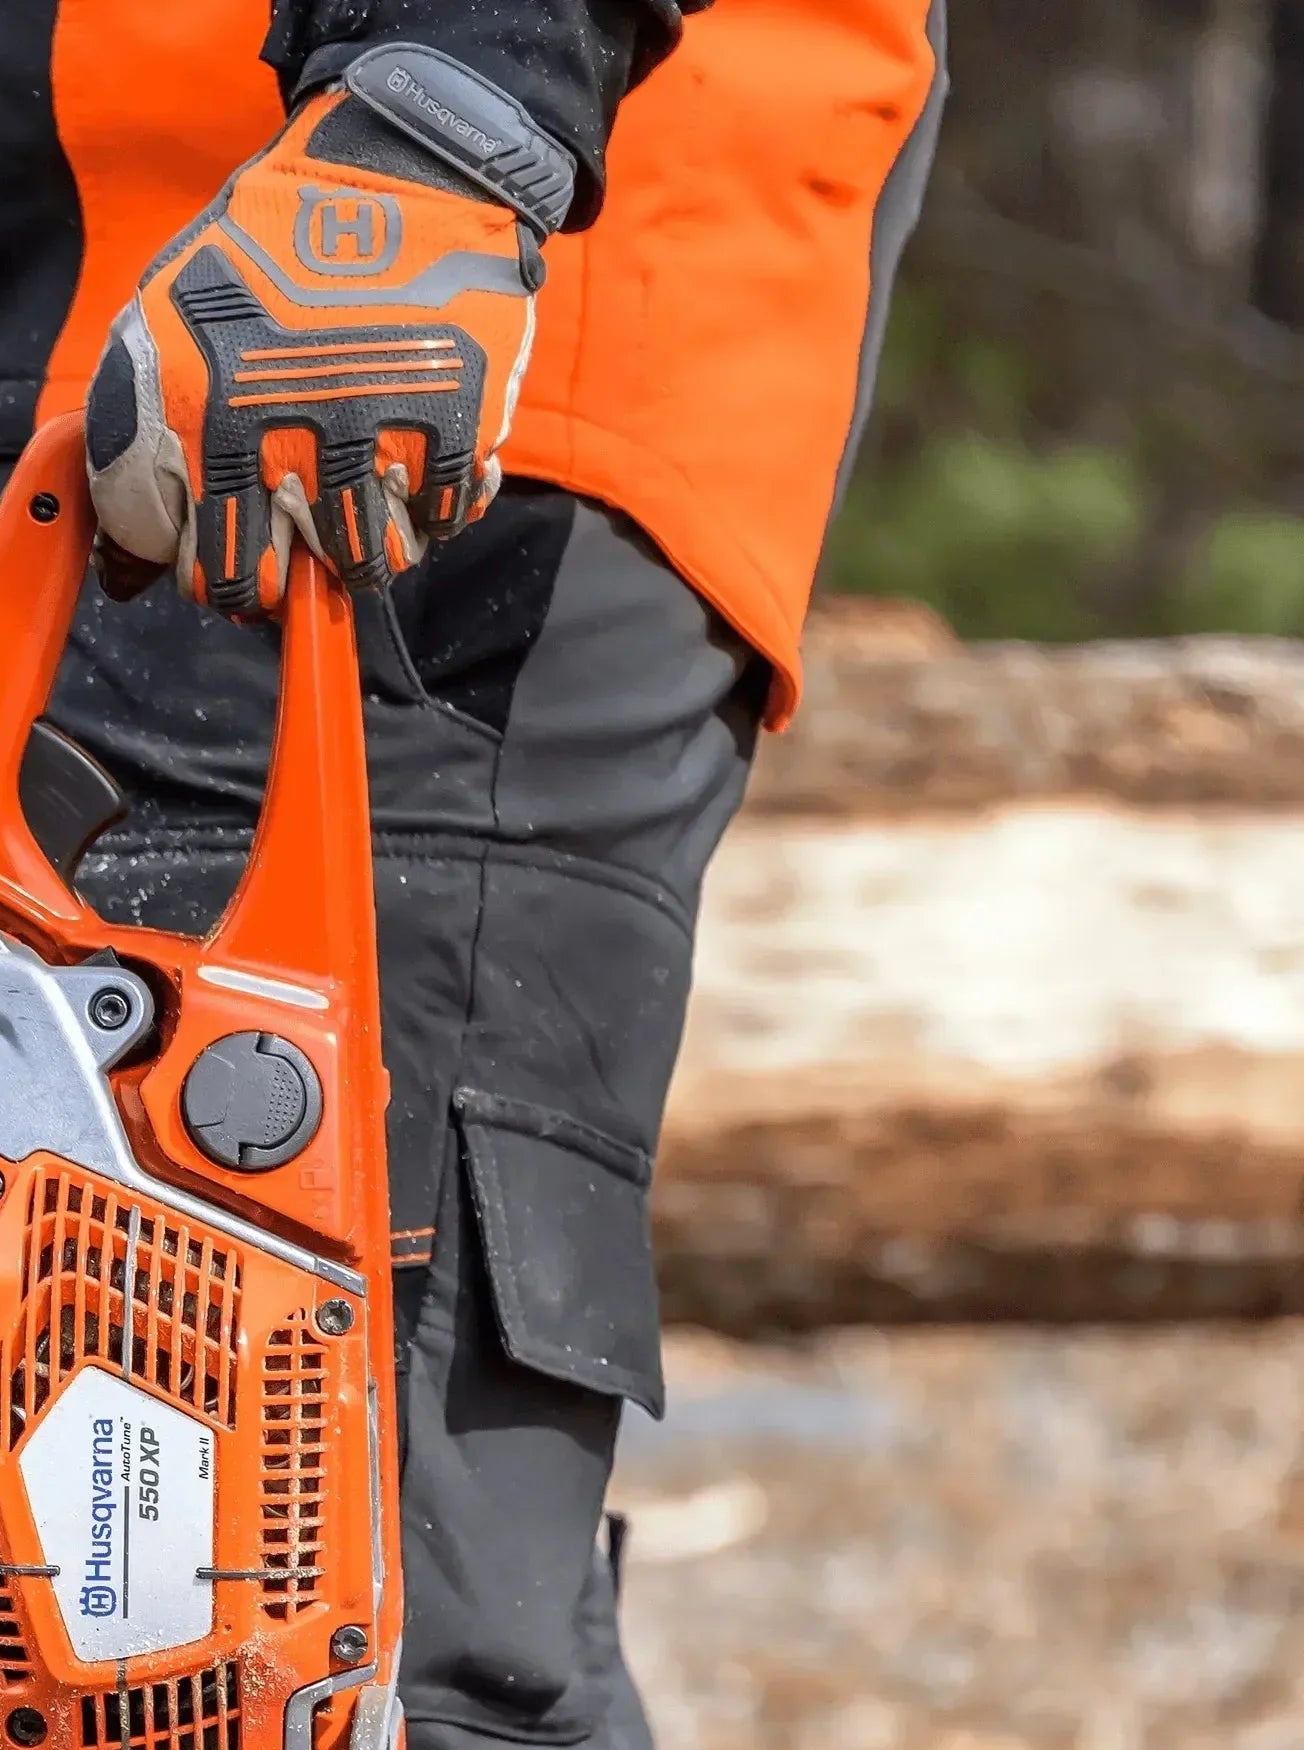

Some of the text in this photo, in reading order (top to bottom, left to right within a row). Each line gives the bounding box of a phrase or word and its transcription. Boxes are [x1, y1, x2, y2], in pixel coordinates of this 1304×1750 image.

[405, 81, 497, 153] Husqvarna
[85, 1418, 117, 1581] Husqvarna
[139, 1427, 160, 1522] 550 XP
[198, 1447, 209, 1480] Mark
